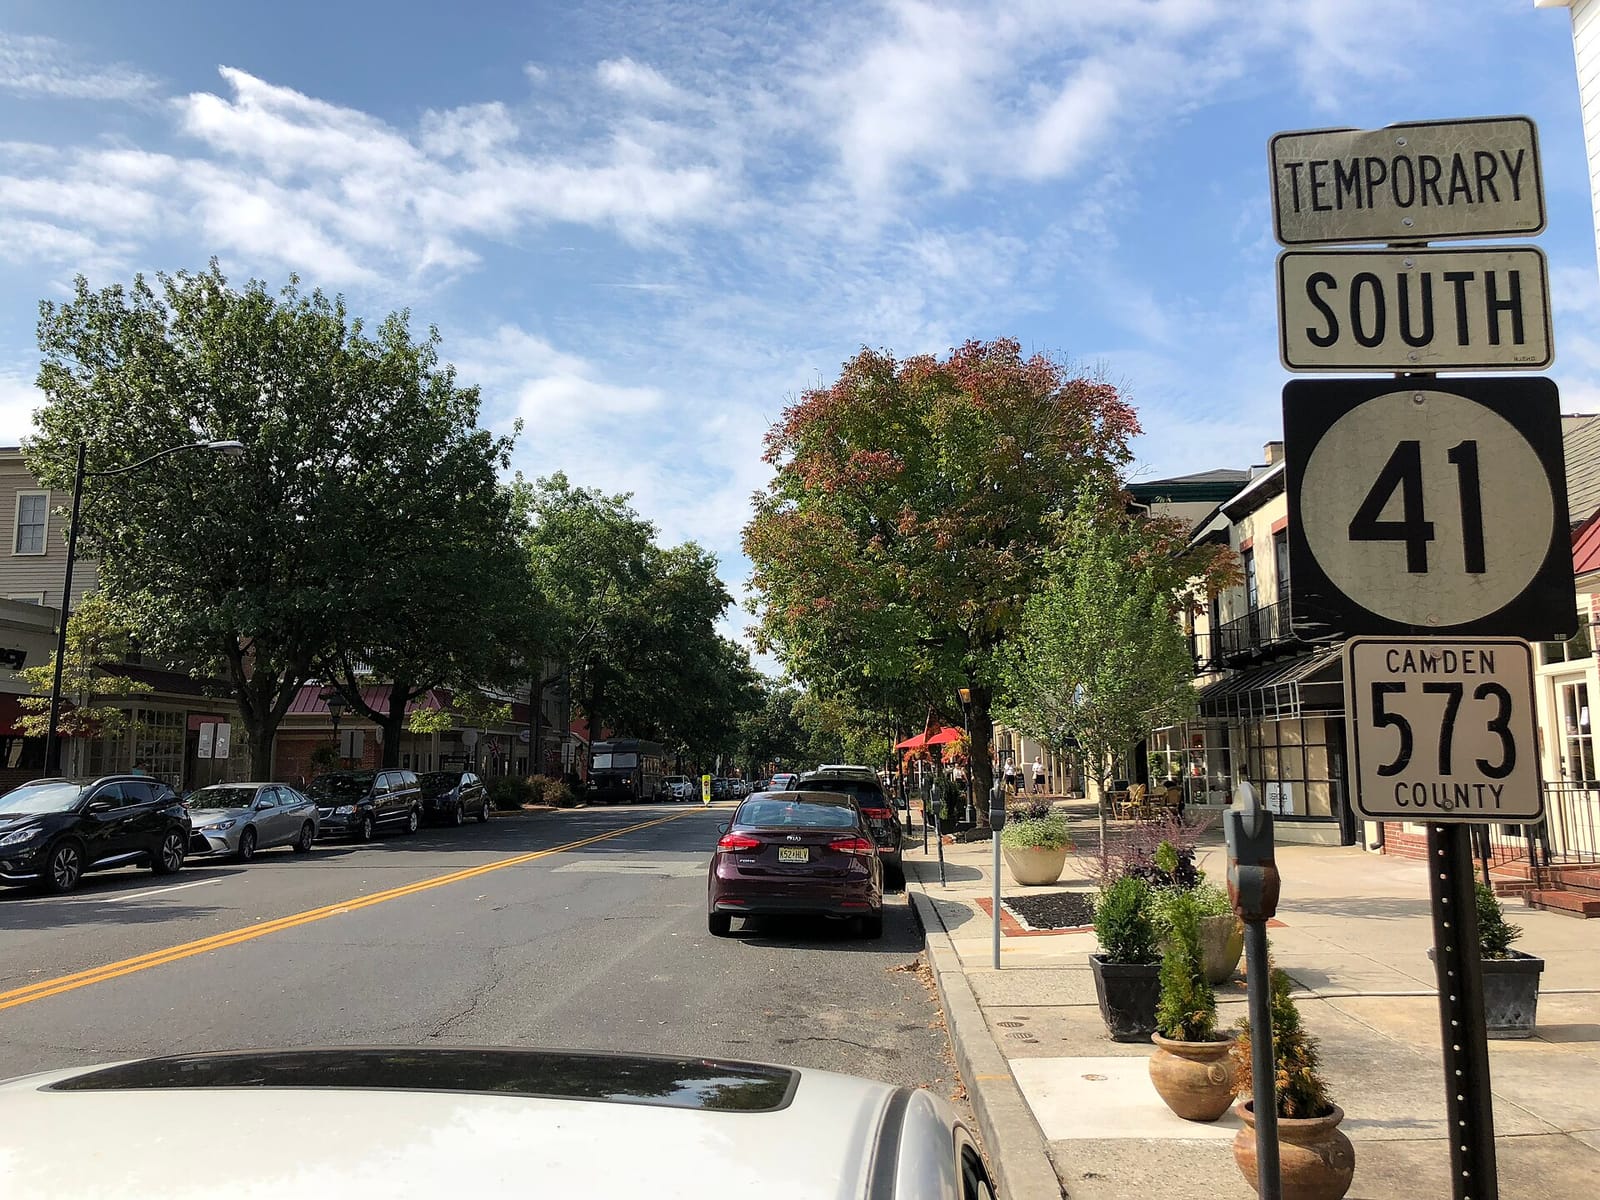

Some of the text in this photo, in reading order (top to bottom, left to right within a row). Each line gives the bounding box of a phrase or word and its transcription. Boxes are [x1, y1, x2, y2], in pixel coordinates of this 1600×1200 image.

[1284, 148, 1525, 213] TEMPORARY
[1305, 270, 1525, 348] SOUTH
[1348, 439, 1486, 574] 41
[1386, 648, 1496, 675] CAMDEN
[1371, 681, 1517, 779] 573
[1394, 782, 1505, 809] COUNTY
